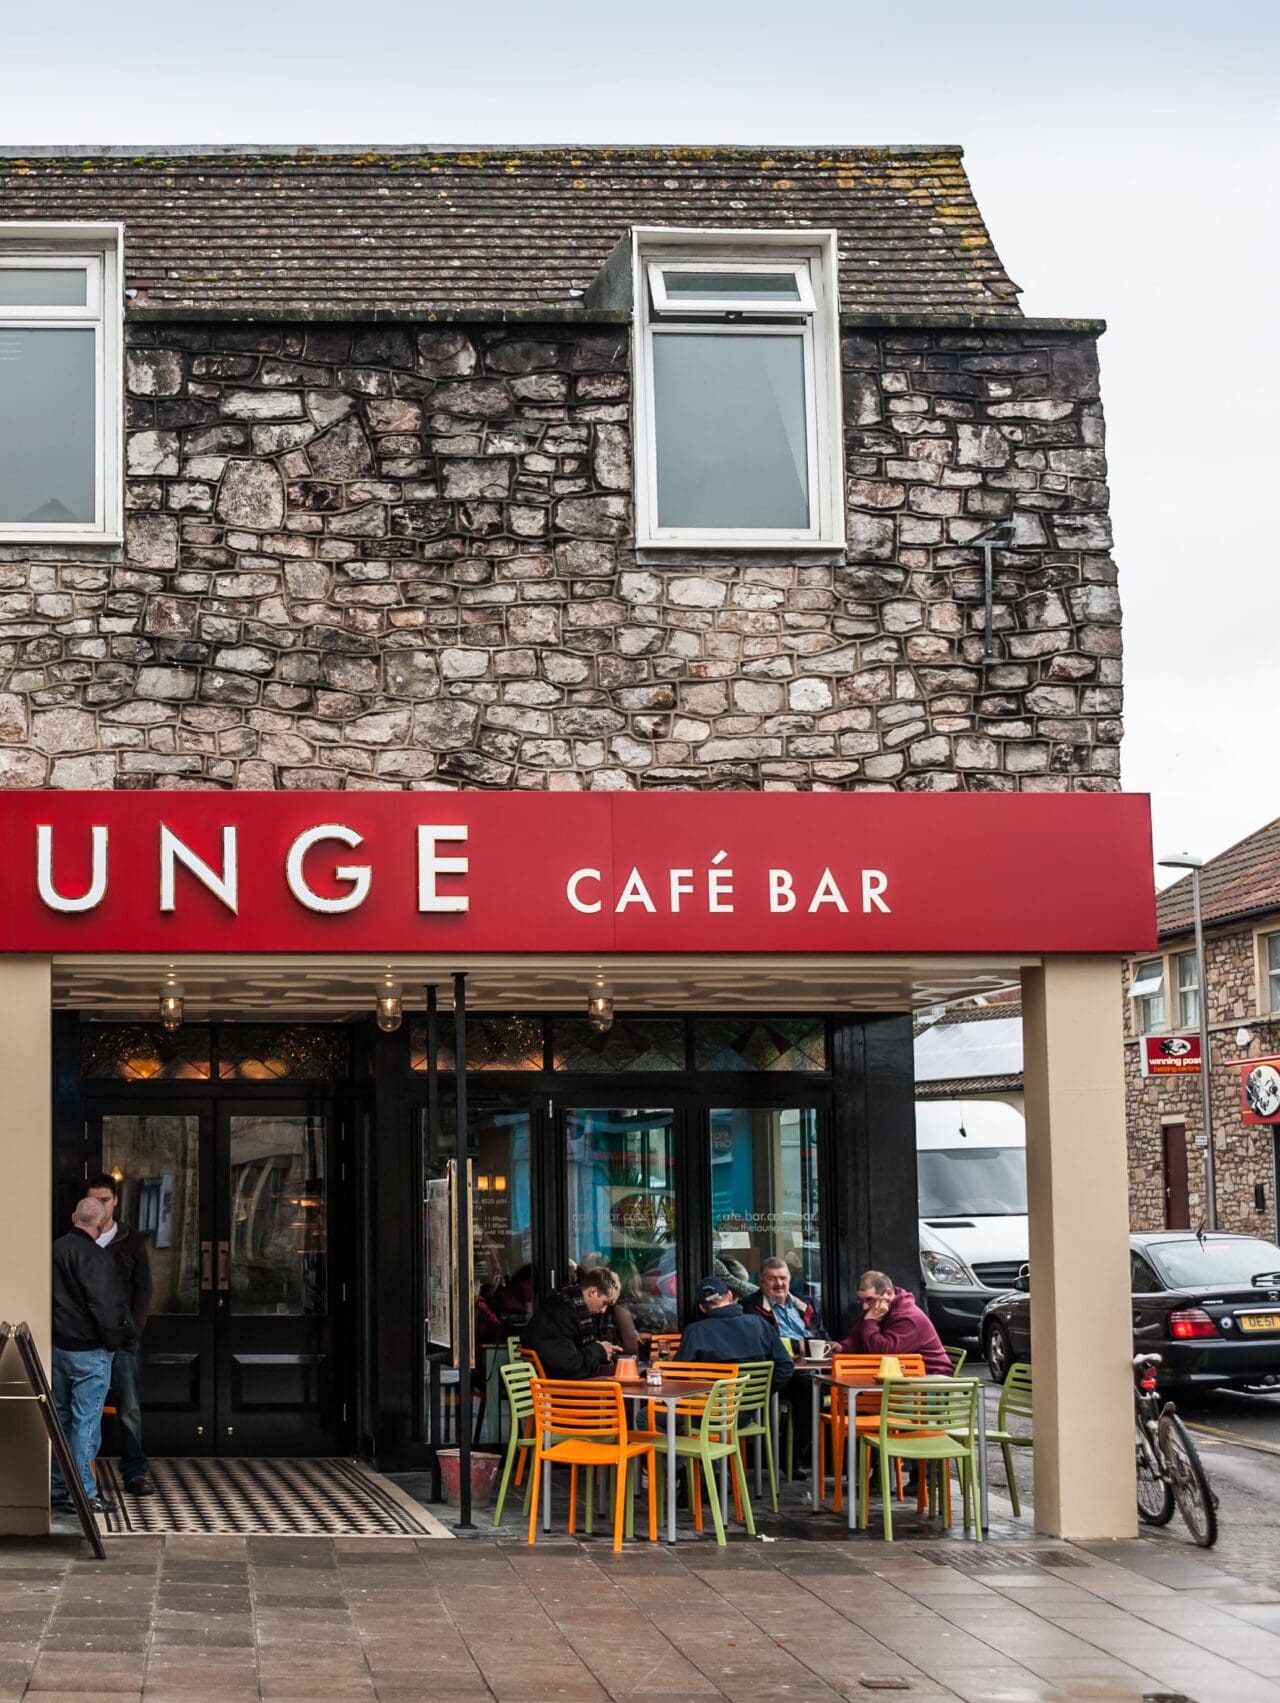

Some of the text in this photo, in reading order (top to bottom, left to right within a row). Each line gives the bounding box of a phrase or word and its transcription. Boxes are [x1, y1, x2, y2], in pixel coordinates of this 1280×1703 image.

[566, 849, 734, 914] CAFÉ
[768, 866, 892, 914] BAR
[1149, 1057, 1202, 1067] winning post
[1153, 1065, 1178, 1073] betting
